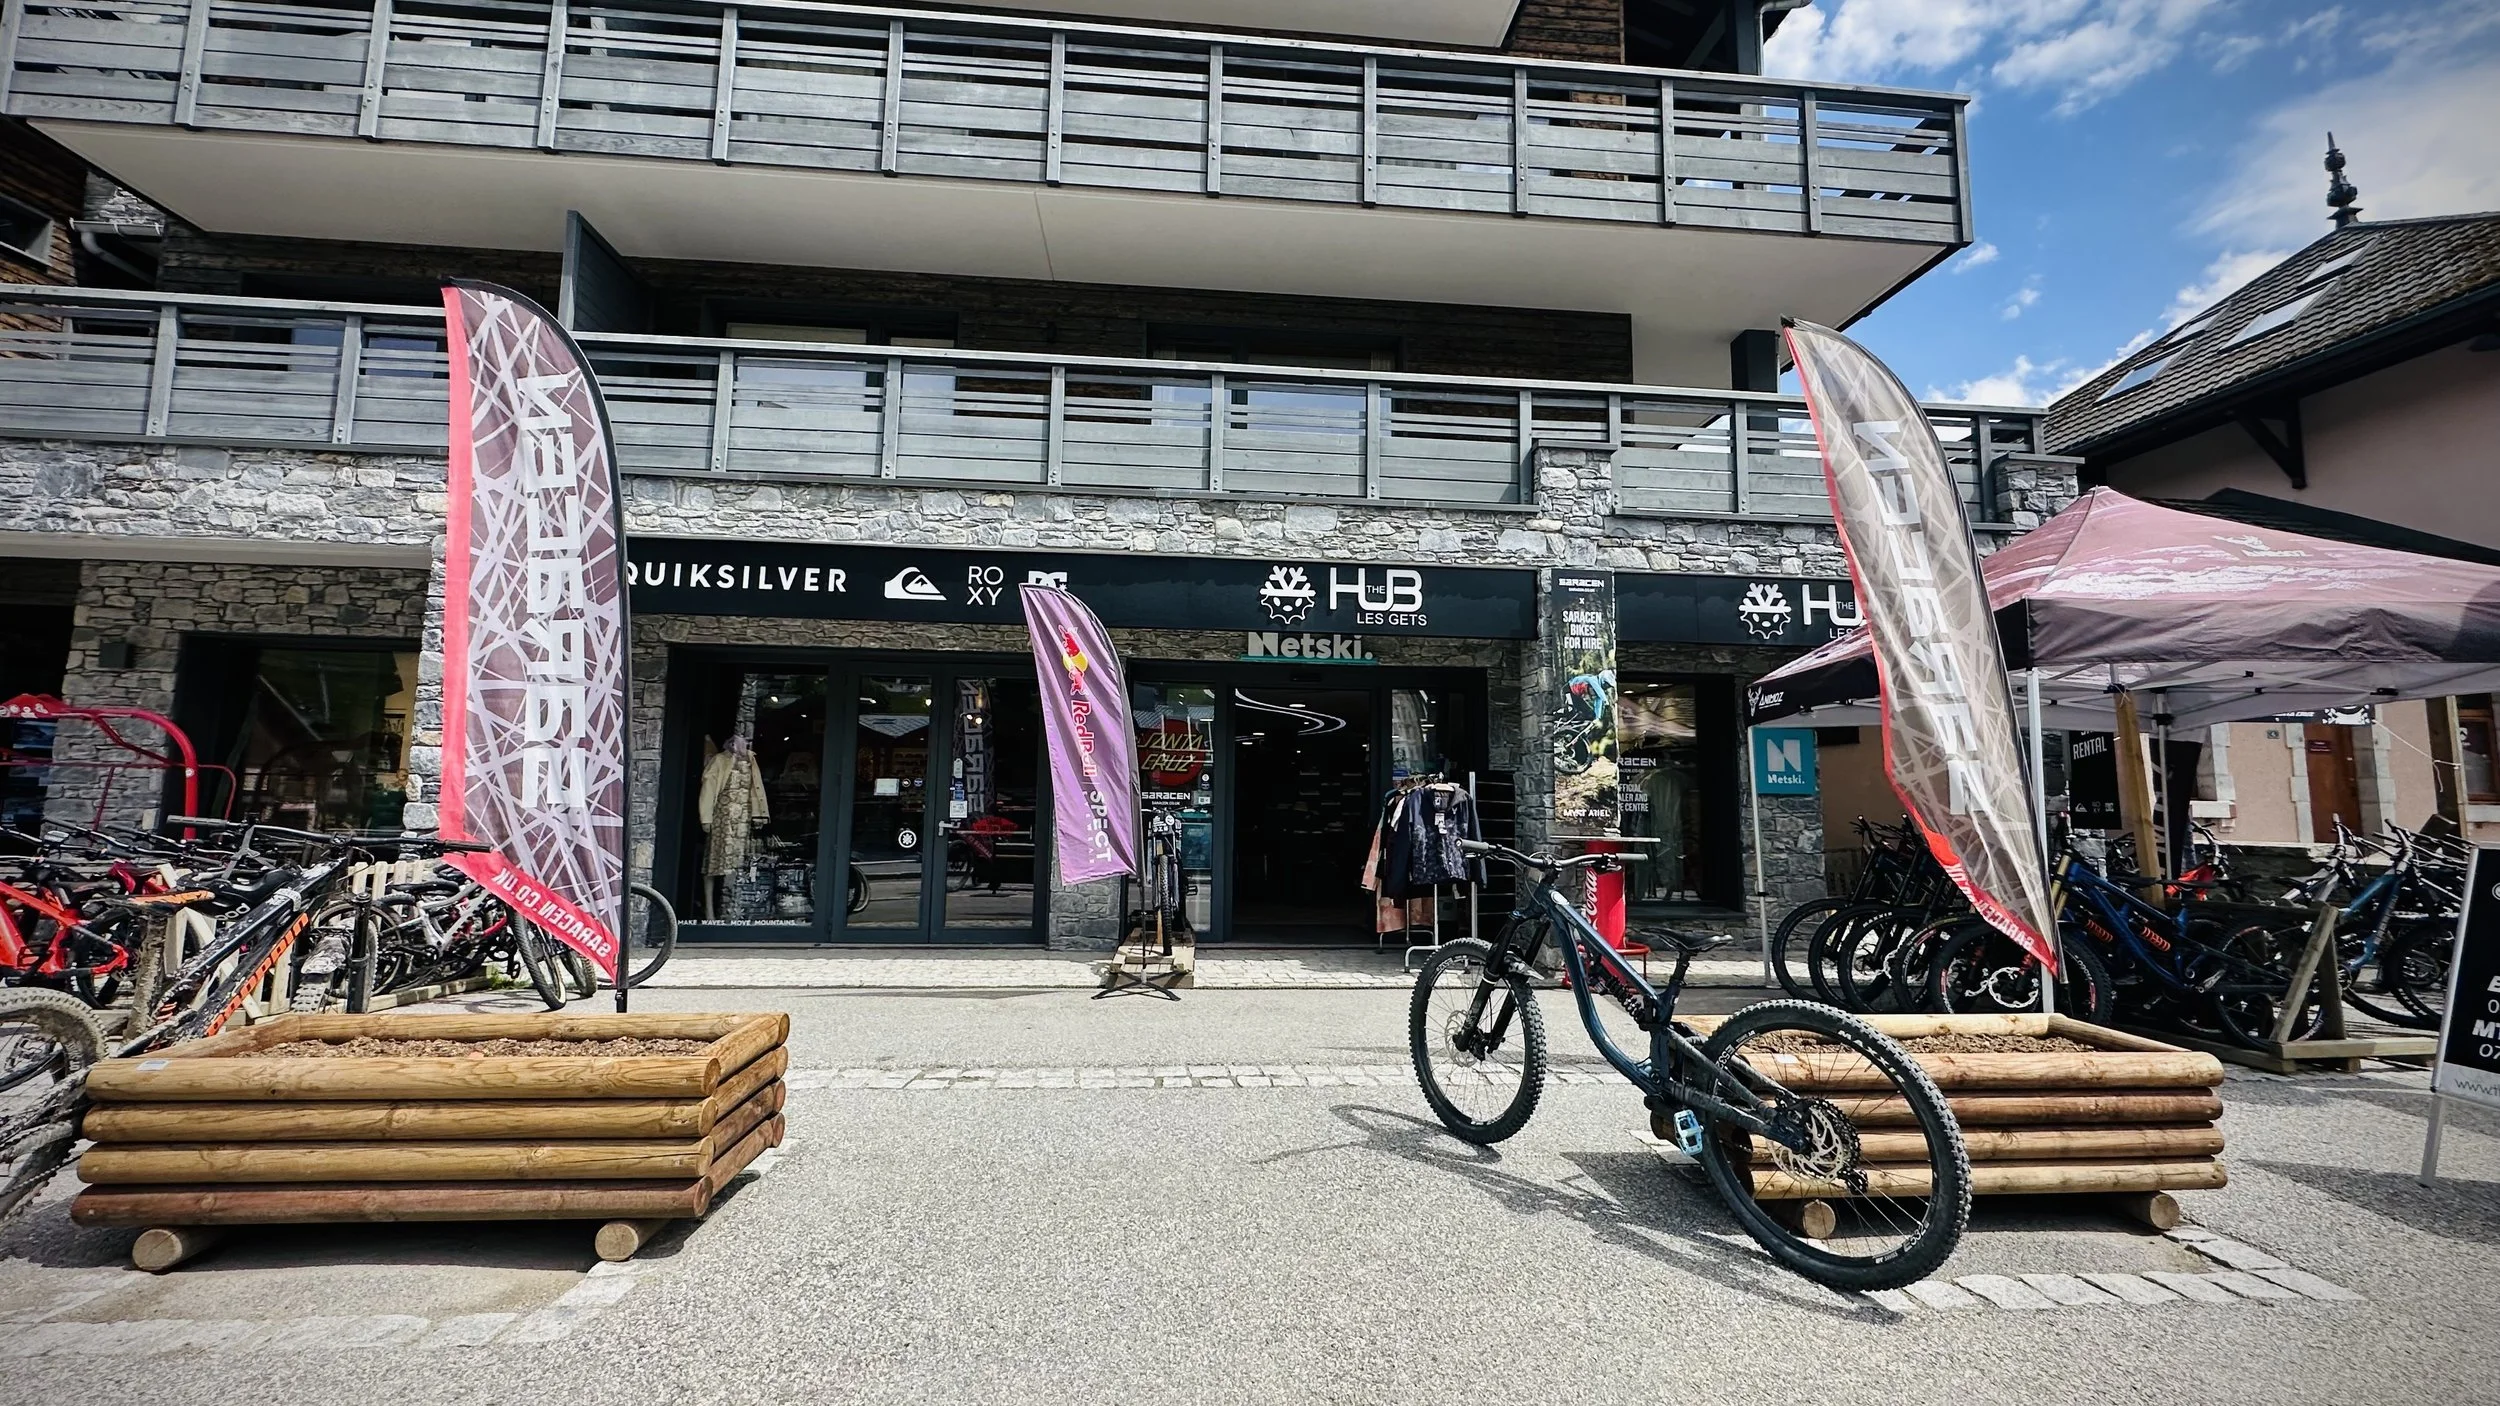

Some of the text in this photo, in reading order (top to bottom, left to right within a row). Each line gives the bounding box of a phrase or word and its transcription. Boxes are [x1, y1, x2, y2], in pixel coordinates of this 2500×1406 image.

[627, 561, 847, 592] QUIKSILVER
[1330, 567, 1423, 613] HUB
[1366, 585, 1386, 594] THE
[1802, 584, 1868, 627] HU
[1836, 601, 1854, 610] THE
[1357, 613, 1428, 626] LES GETS
[1562, 610, 1603, 623] SARACEN
[1570, 624, 1596, 636] BIKES
[1247, 632, 1373, 660] Netski.
[1564, 637, 1603, 650] FOR HIRE
[2072, 735, 2107, 760] RENTAL
[1141, 753, 1196, 771] CRUZ
[1618, 757, 1657, 766] RACEN
[1767, 773, 1805, 785] Netski.
[1619, 783, 1643, 792] FFICIAL
[1624, 803, 1649, 812] CENTRE
[1089, 789, 1112, 862] SPECT
